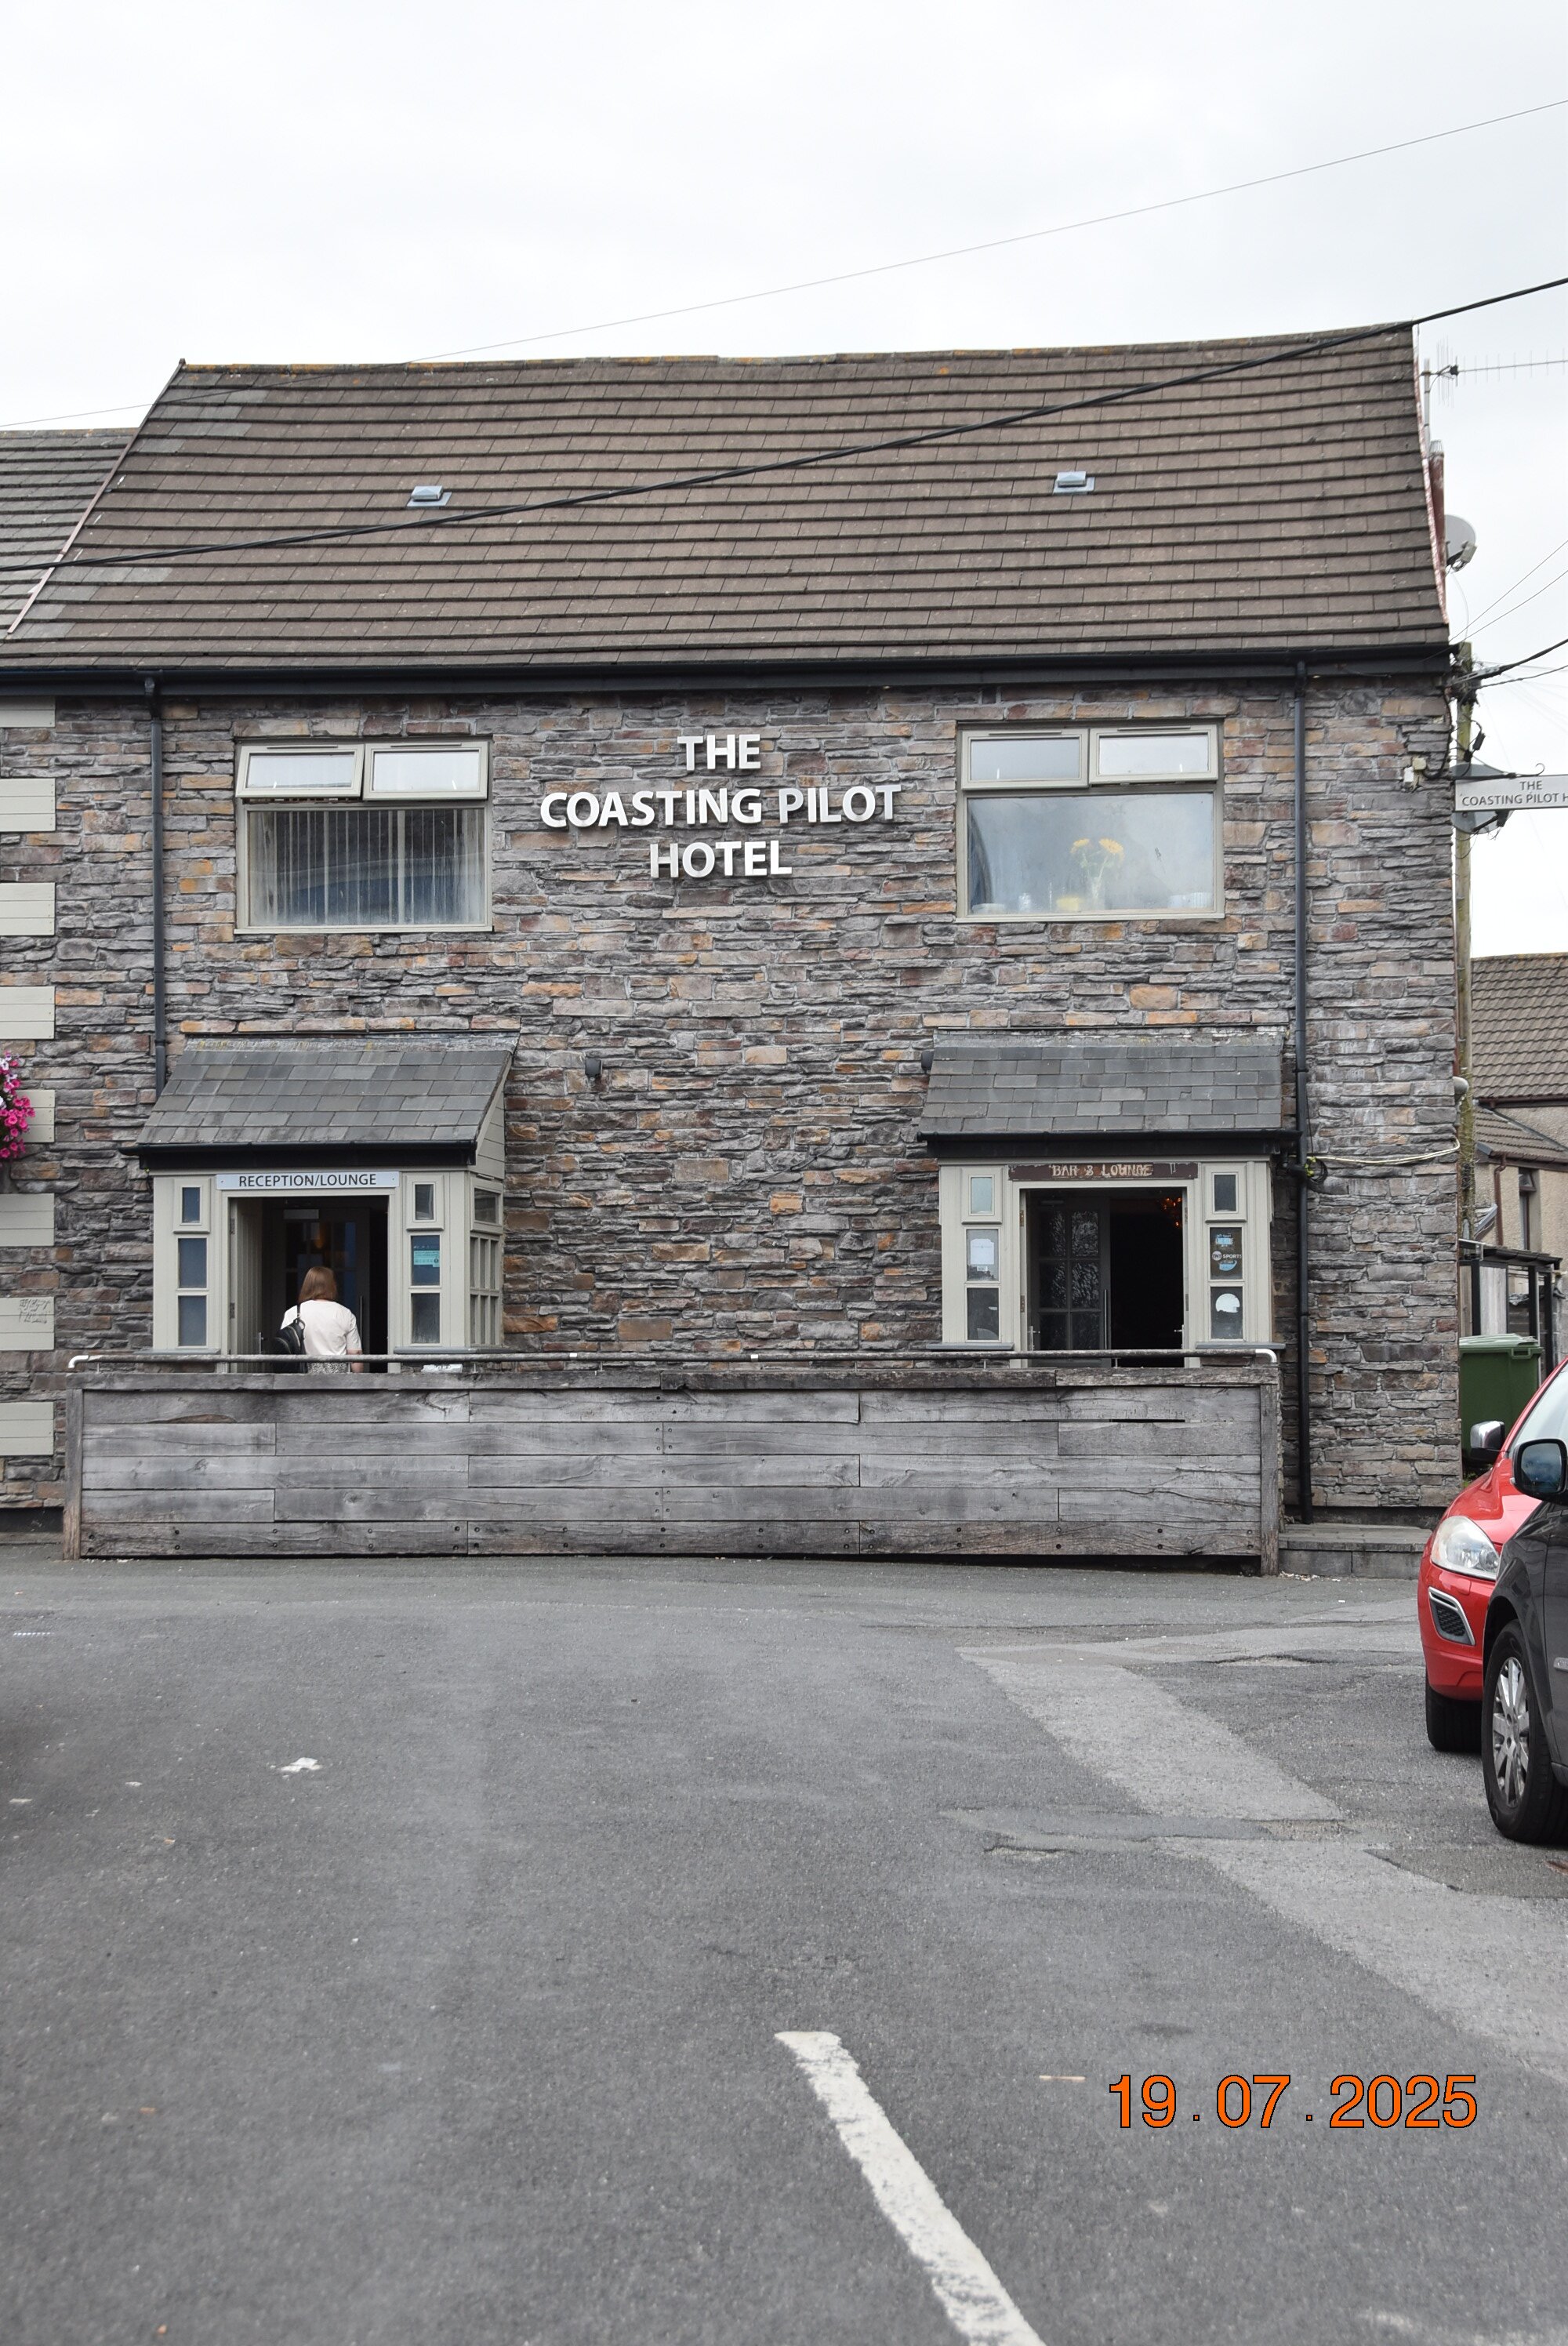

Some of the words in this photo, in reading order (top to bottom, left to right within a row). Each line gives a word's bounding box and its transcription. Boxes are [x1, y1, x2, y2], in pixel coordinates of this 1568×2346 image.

[677, 734, 761, 771] THE
[1519, 780, 1543, 791] THE
[540, 788, 762, 827] COASTING
[779, 784, 902, 823] PILOT
[1462, 794, 1523, 806] COASTING
[1526, 793, 1559, 804] PILOT
[650, 840, 793, 878] HOTEL
[1051, 1164, 1079, 1177] BAR
[238, 1173, 377, 1187] RECEPTION/LOUNGE
